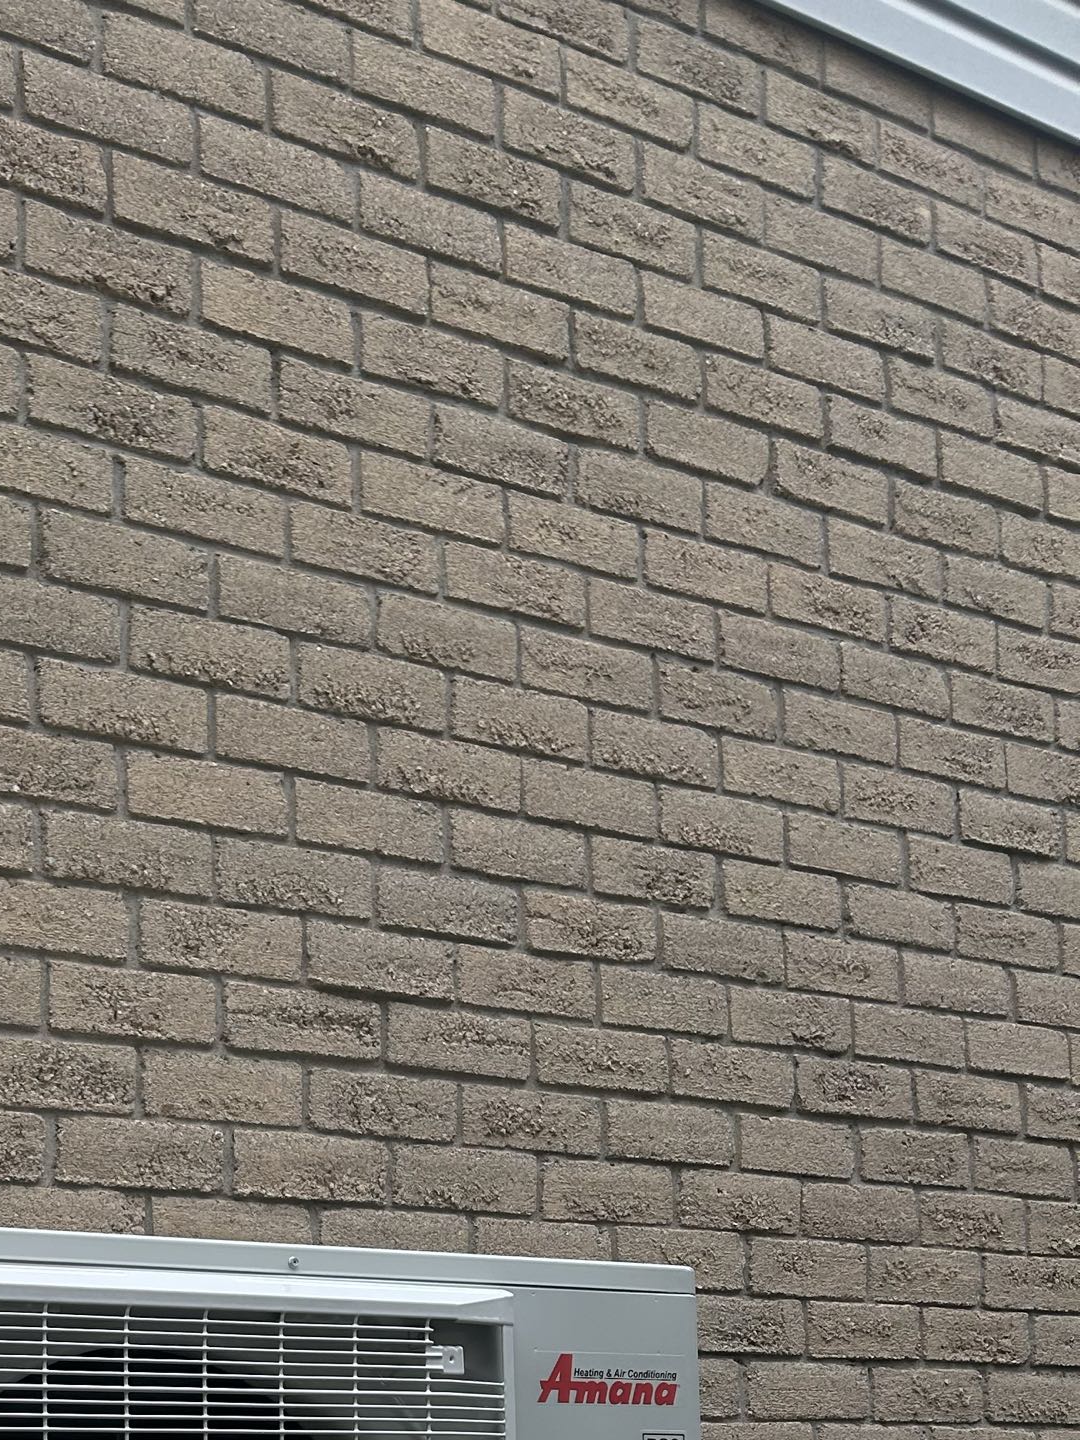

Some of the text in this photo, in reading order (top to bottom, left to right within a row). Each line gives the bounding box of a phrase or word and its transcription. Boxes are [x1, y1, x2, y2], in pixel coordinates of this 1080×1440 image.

[537, 1353, 678, 1406] Amana
[573, 1368, 677, 1380] Heating & Air Conditioning
